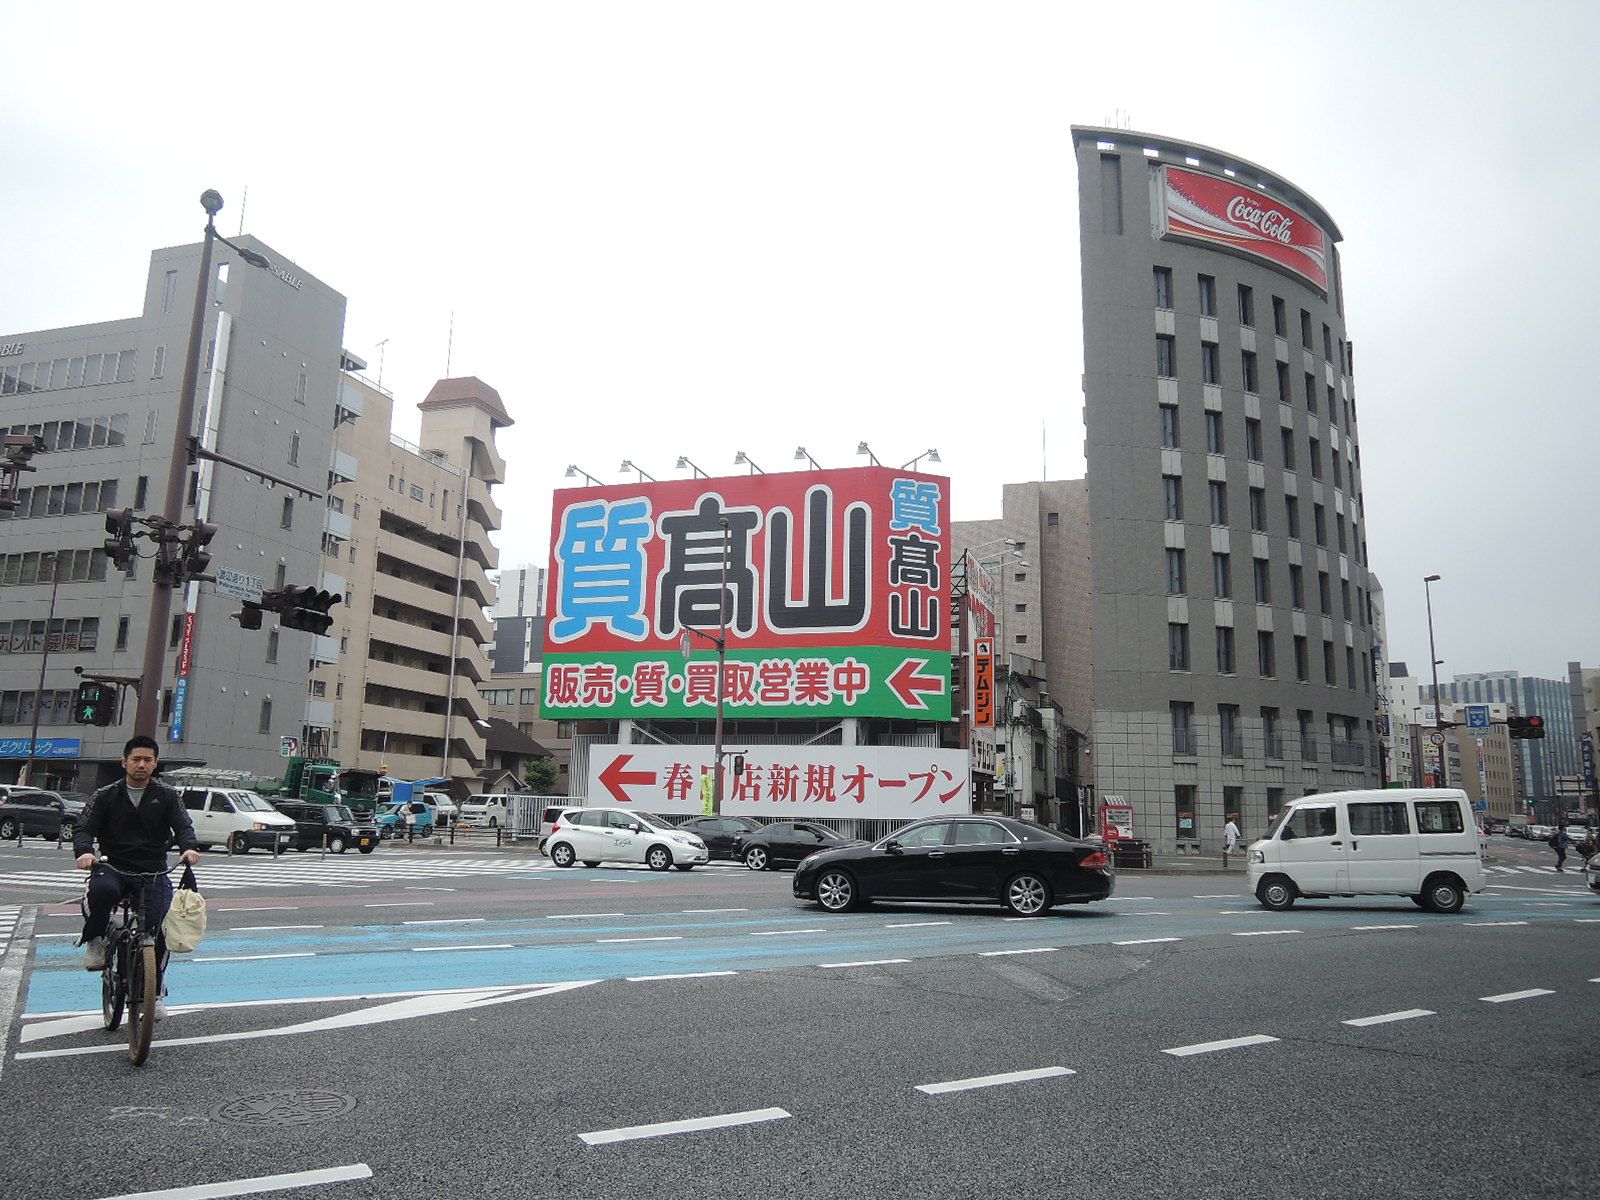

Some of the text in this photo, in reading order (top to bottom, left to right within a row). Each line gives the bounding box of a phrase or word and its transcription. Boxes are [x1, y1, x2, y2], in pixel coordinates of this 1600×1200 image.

[1226, 196, 1294, 243] Coca-Cola
[0, 342, 24, 356] BLE
[976, 658, 990, 725] テムジン
